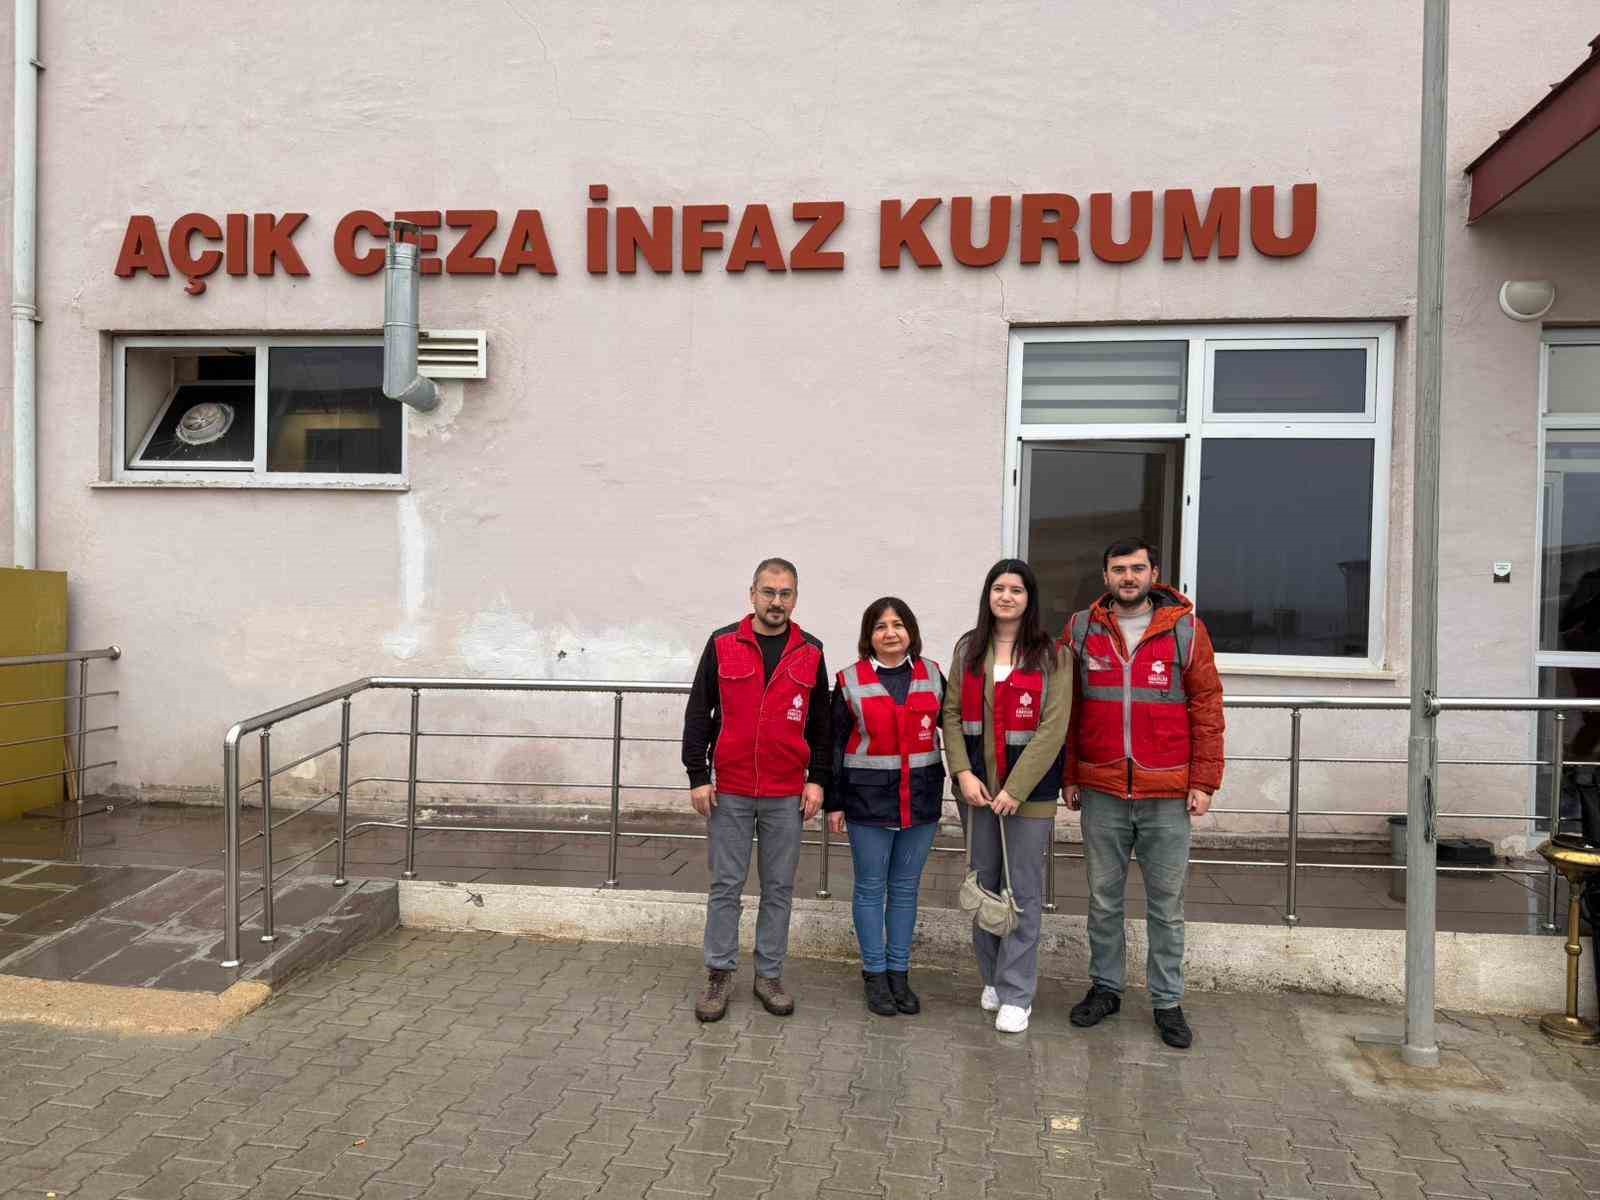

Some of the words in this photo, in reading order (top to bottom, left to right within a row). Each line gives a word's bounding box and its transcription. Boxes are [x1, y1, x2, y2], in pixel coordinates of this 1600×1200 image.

[115, 212, 309, 296] AÇIK
[334, 209, 557, 278] CEZA
[587, 184, 845, 275] İNFAZ
[879, 183, 1318, 270] KURUMU
